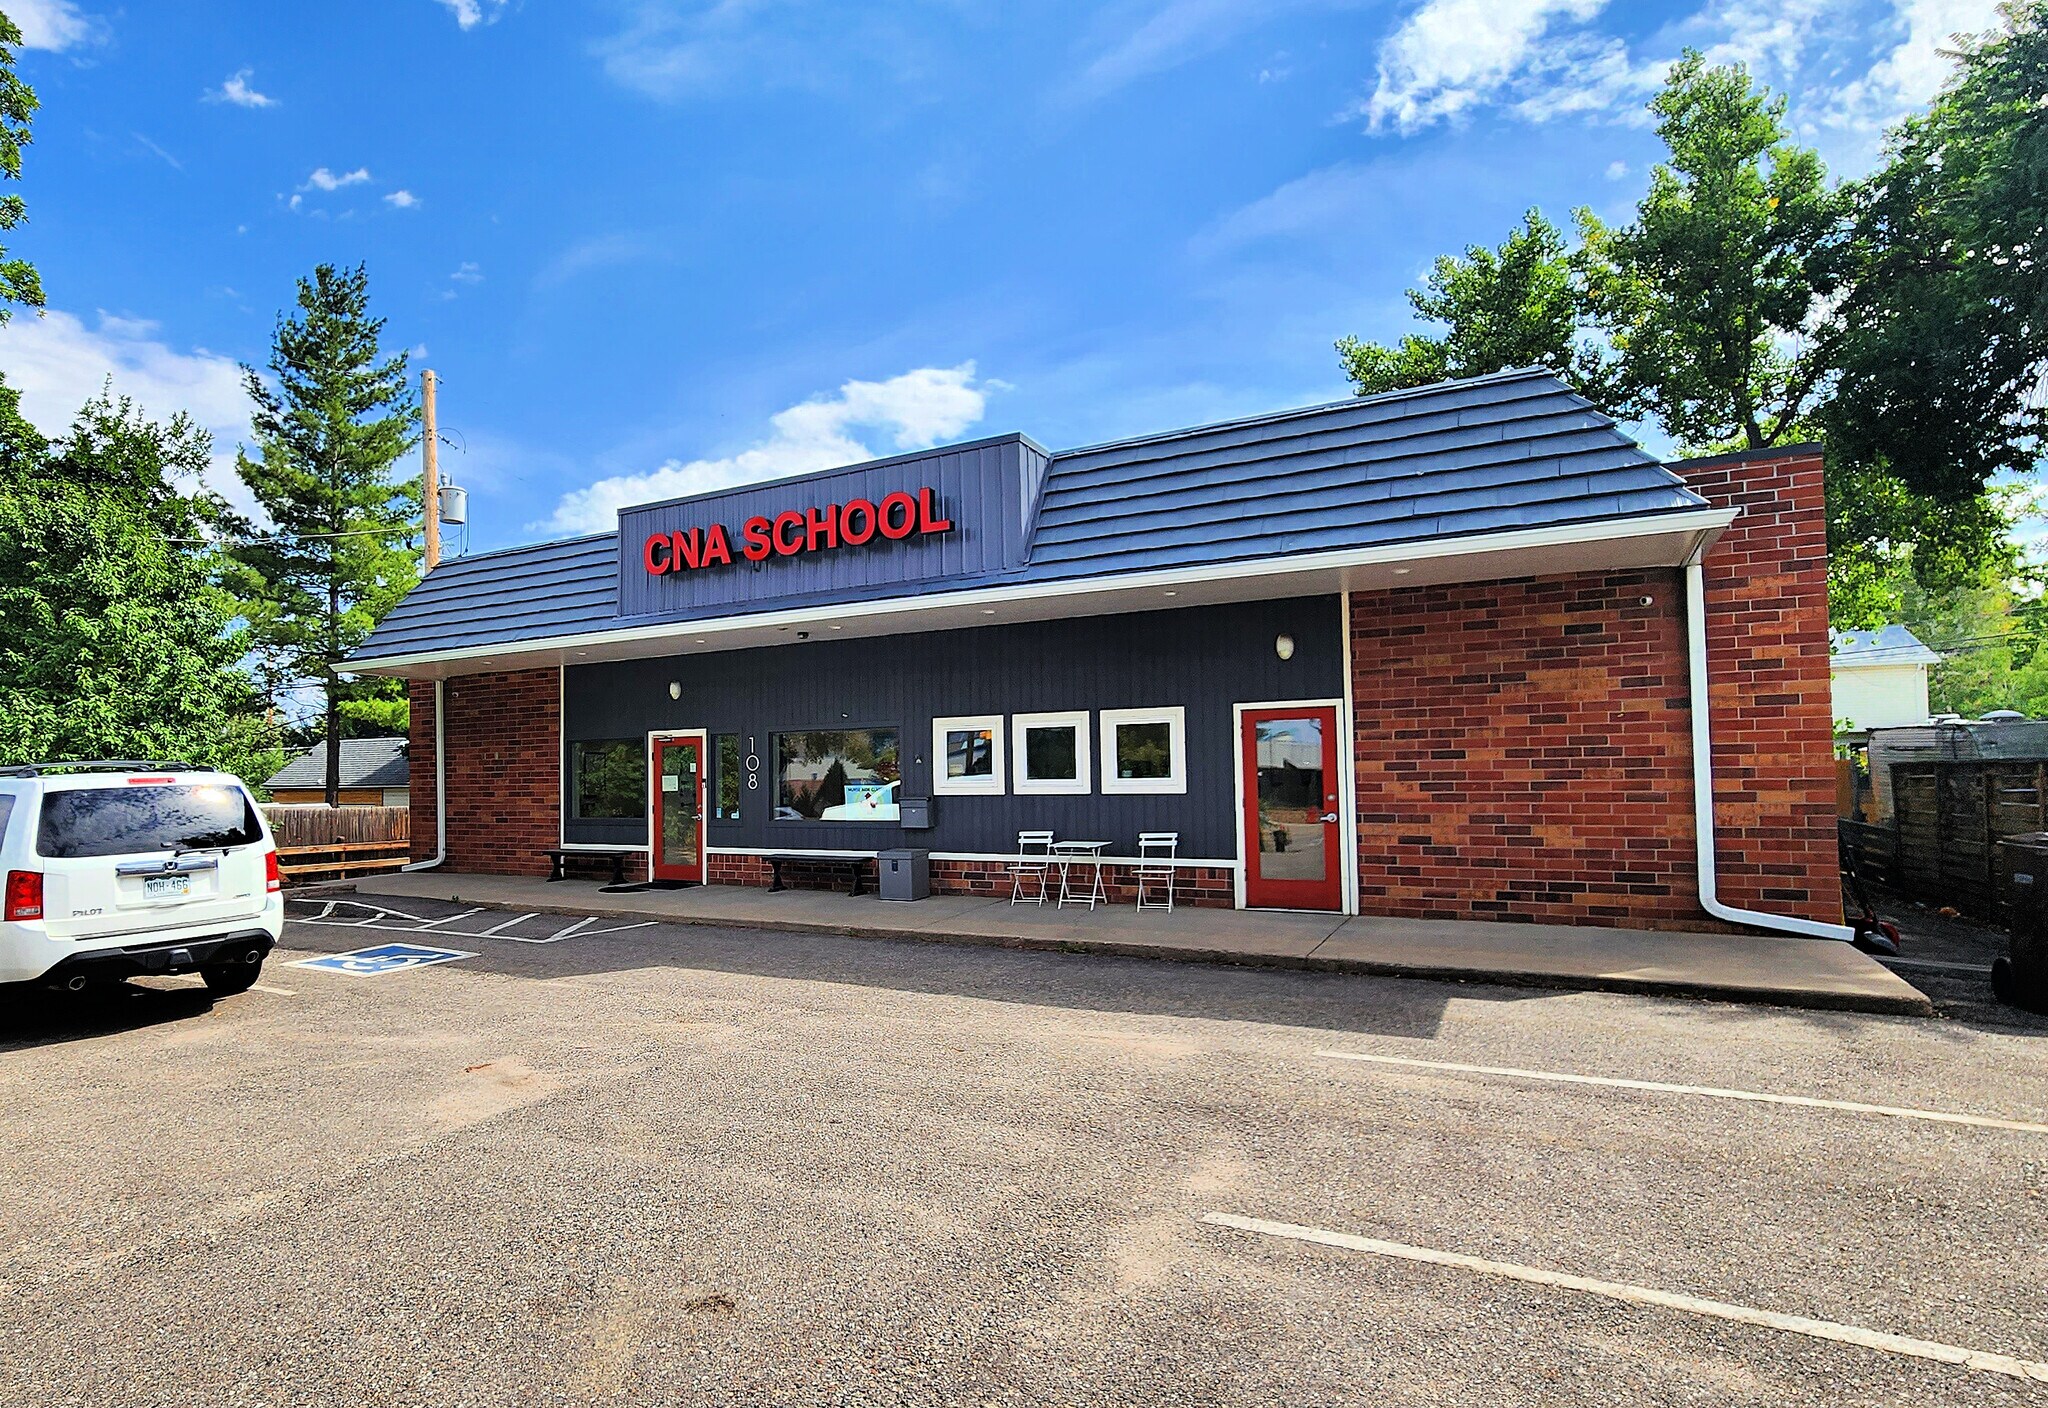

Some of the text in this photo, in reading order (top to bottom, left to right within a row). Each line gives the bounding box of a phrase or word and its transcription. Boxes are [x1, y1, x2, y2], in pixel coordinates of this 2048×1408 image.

[643, 487, 953, 576] CNA SCHOOL
[745, 736, 760, 790] 108
[72, 907, 103, 917] PILOT
